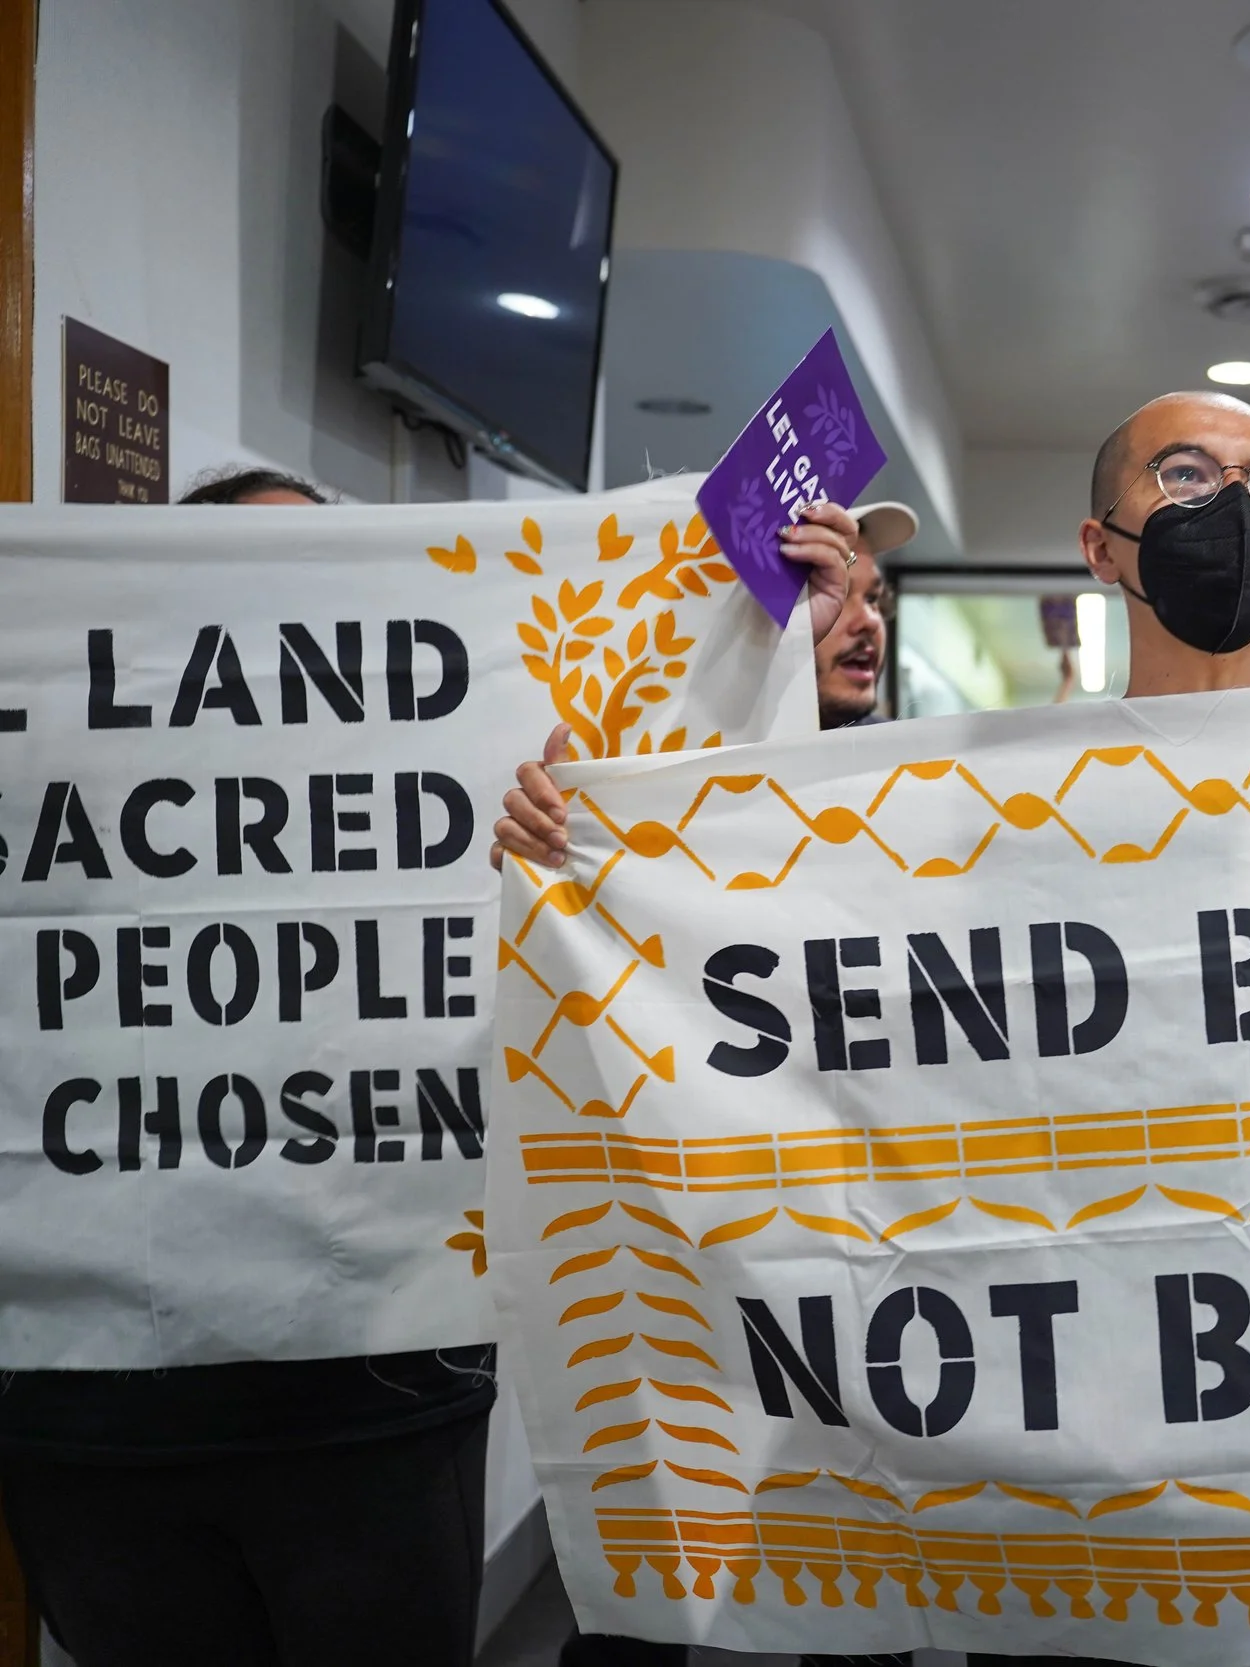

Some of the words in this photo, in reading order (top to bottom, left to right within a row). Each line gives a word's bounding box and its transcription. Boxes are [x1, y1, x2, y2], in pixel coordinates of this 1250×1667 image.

[76, 397, 108, 429] NOT
[119, 414, 160, 450] LEAVE
[79, 364, 128, 404] PLEASE
[138, 389, 159, 417] DO
[75, 431, 100, 460] BAGS
[105, 442, 161, 481] UNATTENDED
[765, 397, 799, 454] LET
[793, 455, 830, 507] GAZ
[765, 453, 806, 525] LIVE
[87, 618, 470, 730] LAND
[0, 771, 475, 882] ACRED
[36, 917, 477, 1031] PEOPLE
[702, 920, 1130, 1078] SEND
[42, 1067, 485, 1176] CHOSEN
[735, 1279, 1080, 1438] NOT
